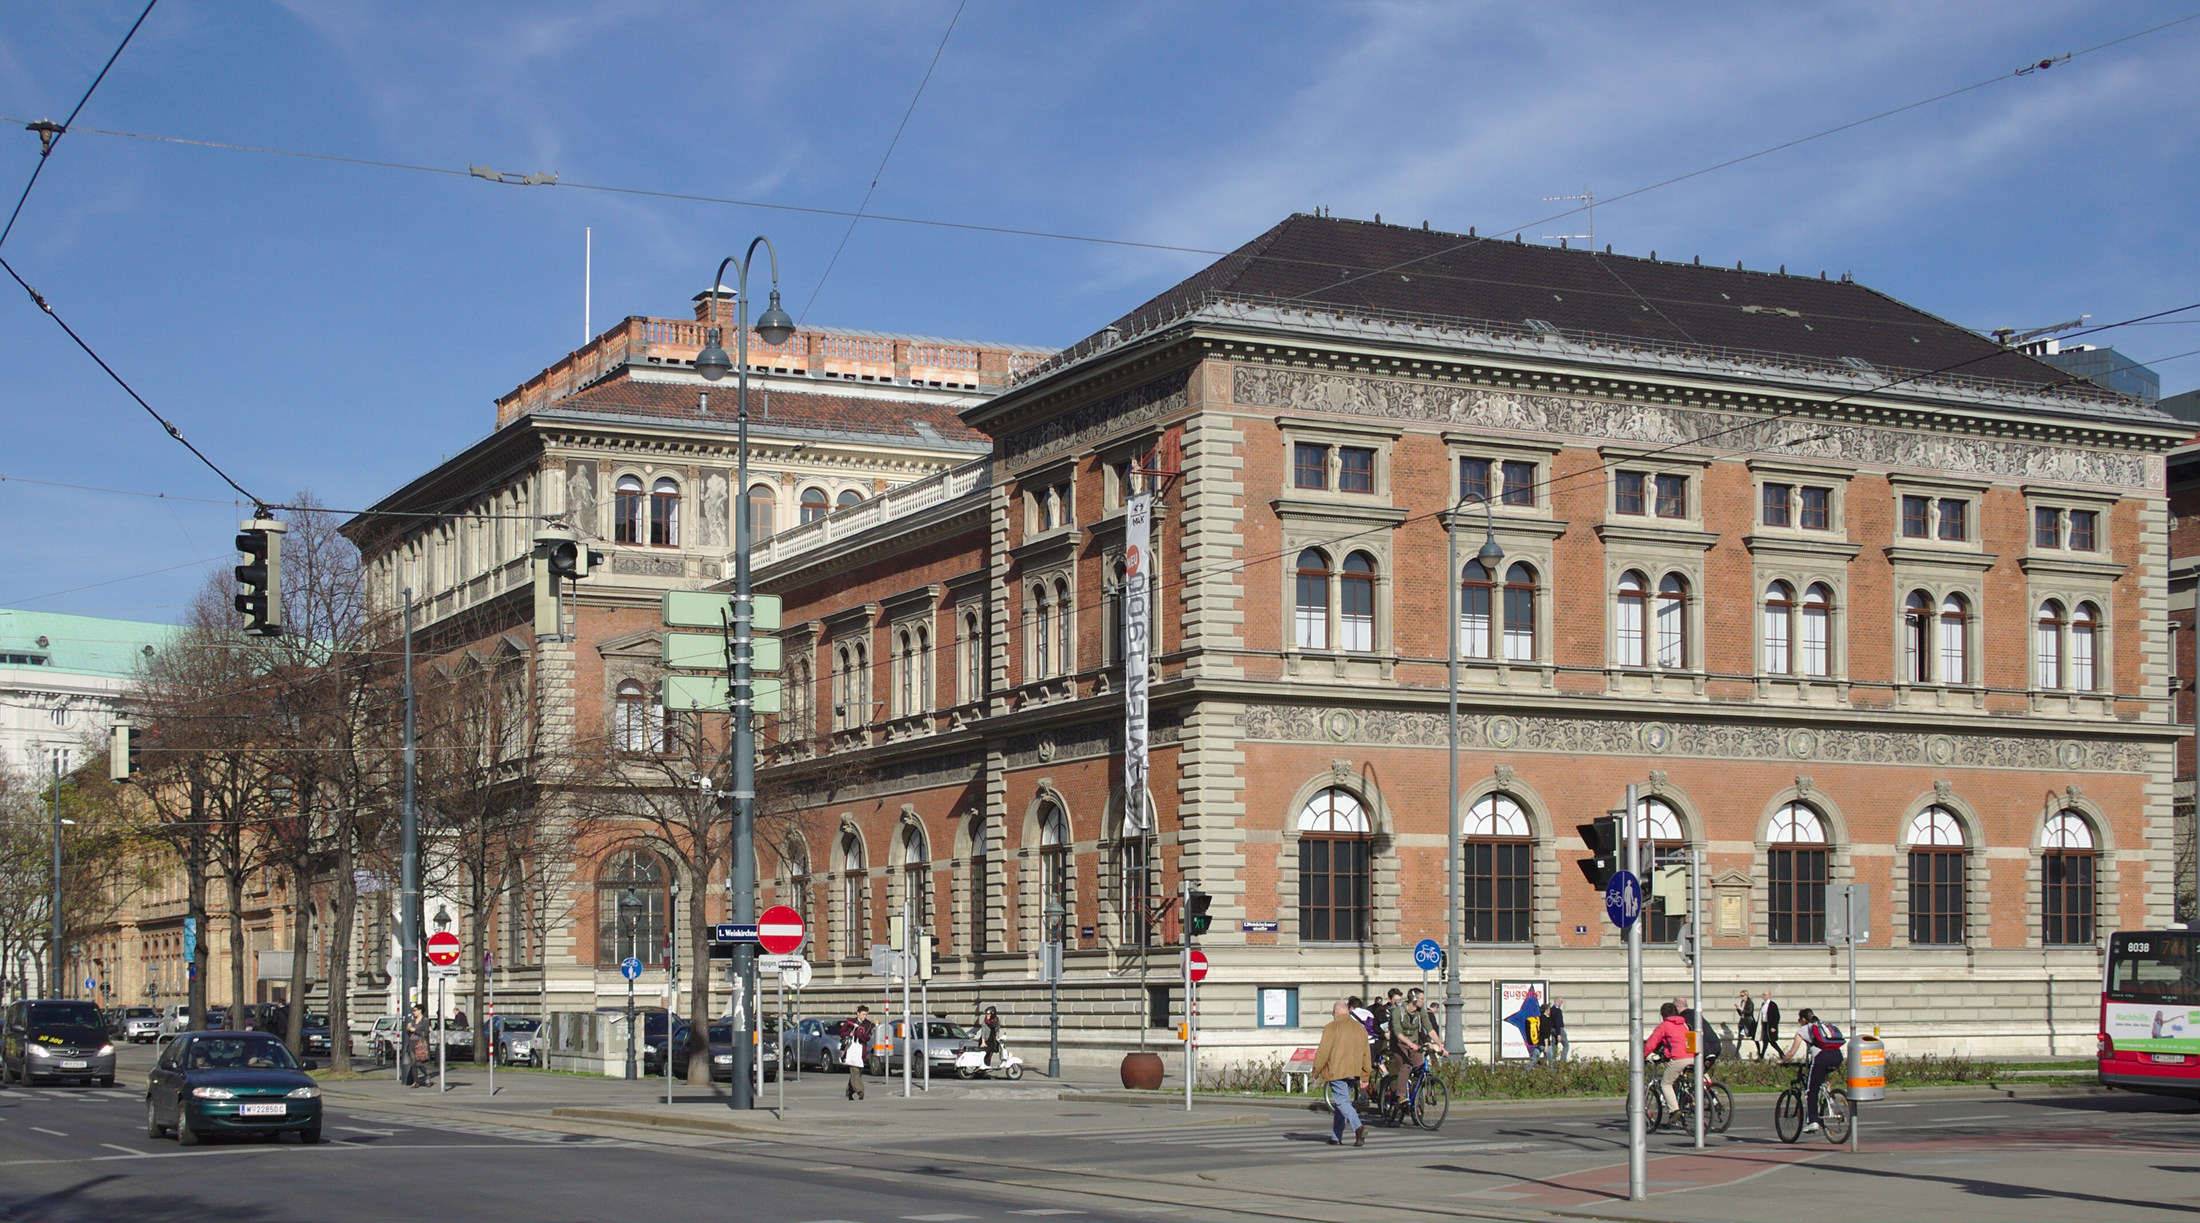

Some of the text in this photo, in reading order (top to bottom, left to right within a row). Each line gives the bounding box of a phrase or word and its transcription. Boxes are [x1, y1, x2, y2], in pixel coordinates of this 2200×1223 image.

[1132, 516, 1145, 526] MAK
[1127, 571, 1145, 772] WIEN 1900
[725, 929, 758, 937] Weiskirchne
[2128, 943, 2149, 952] 8038
[1503, 990, 1542, 1000] gugging
